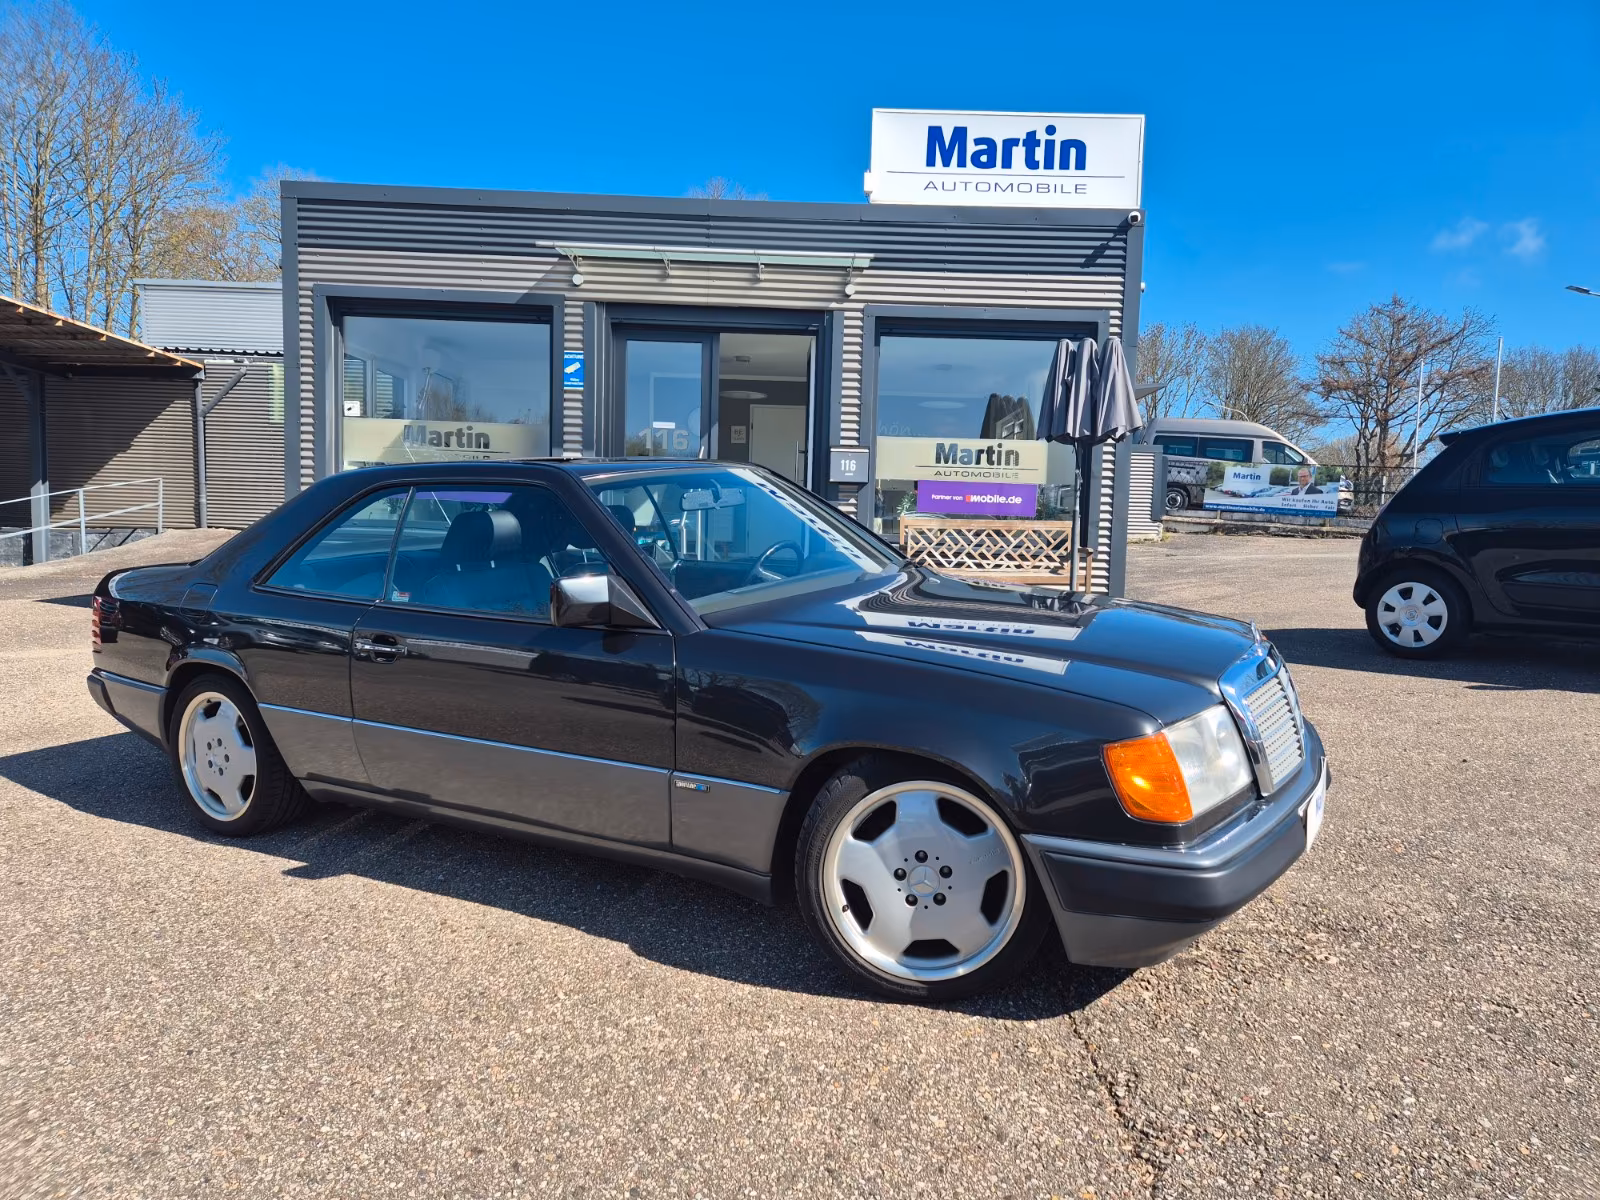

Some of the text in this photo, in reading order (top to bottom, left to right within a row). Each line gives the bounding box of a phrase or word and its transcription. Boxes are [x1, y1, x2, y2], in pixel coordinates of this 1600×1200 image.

[926, 125, 1086, 170] Martin
[924, 181, 1087, 194] AUTOMOBILE
[403, 425, 490, 450] Martin
[639, 427, 690, 450] 116
[935, 442, 1020, 467] Martin
[841, 459, 857, 472] 116
[933, 470, 1019, 479] AUTOMOBILE
[1232, 471, 1261, 481] Martin
[931, 493, 952, 501] Partner
